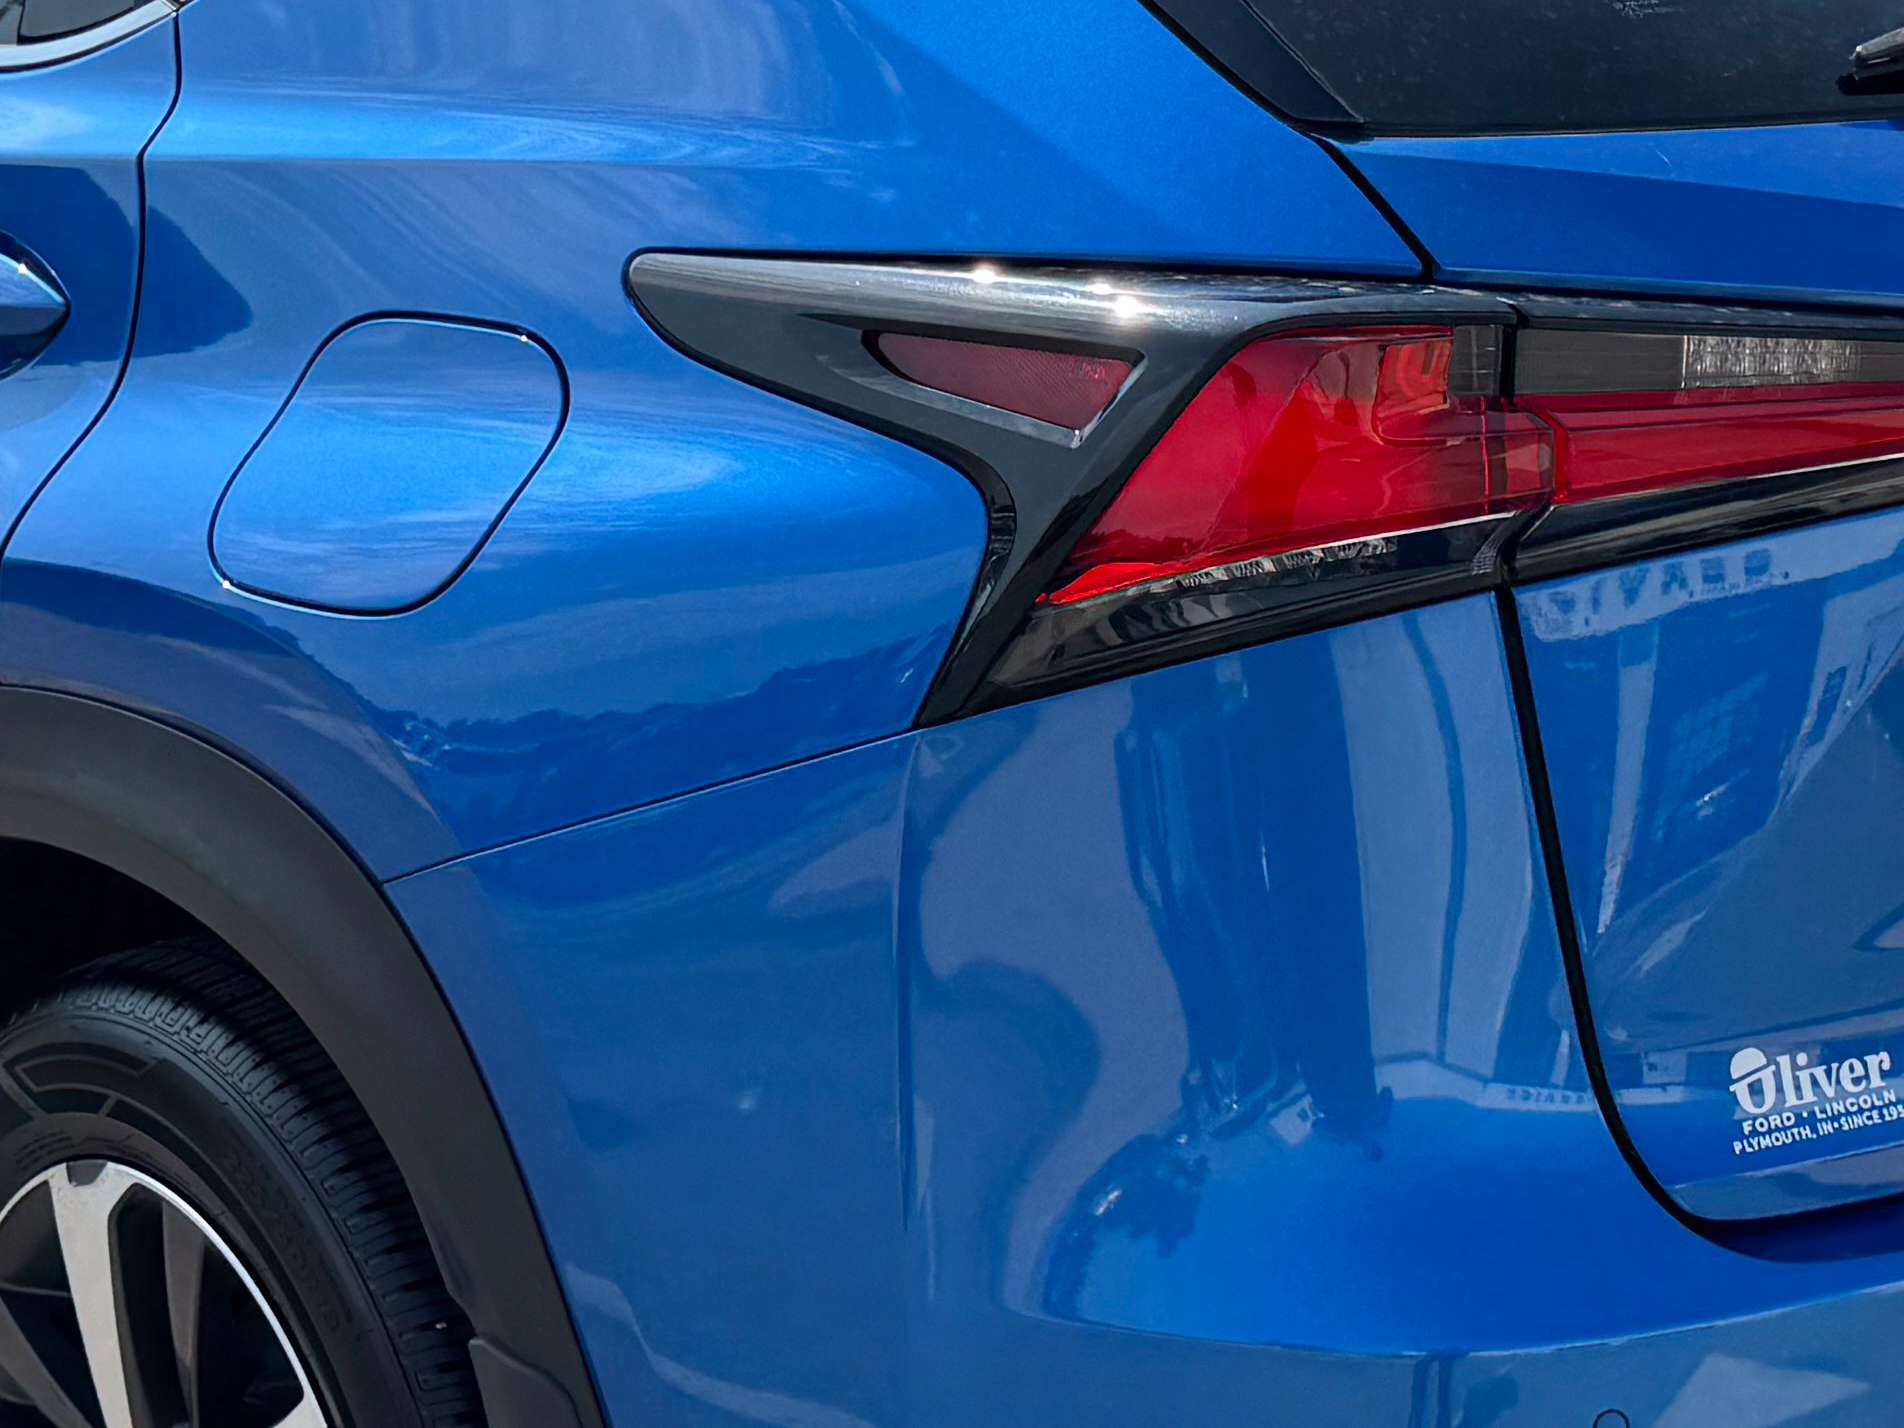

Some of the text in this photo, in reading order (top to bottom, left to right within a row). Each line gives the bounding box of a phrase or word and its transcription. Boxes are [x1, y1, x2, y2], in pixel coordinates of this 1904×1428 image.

[1729, 1047, 1891, 1115] Oliver
[1742, 1089, 1896, 1135] FORD LINCOLN
